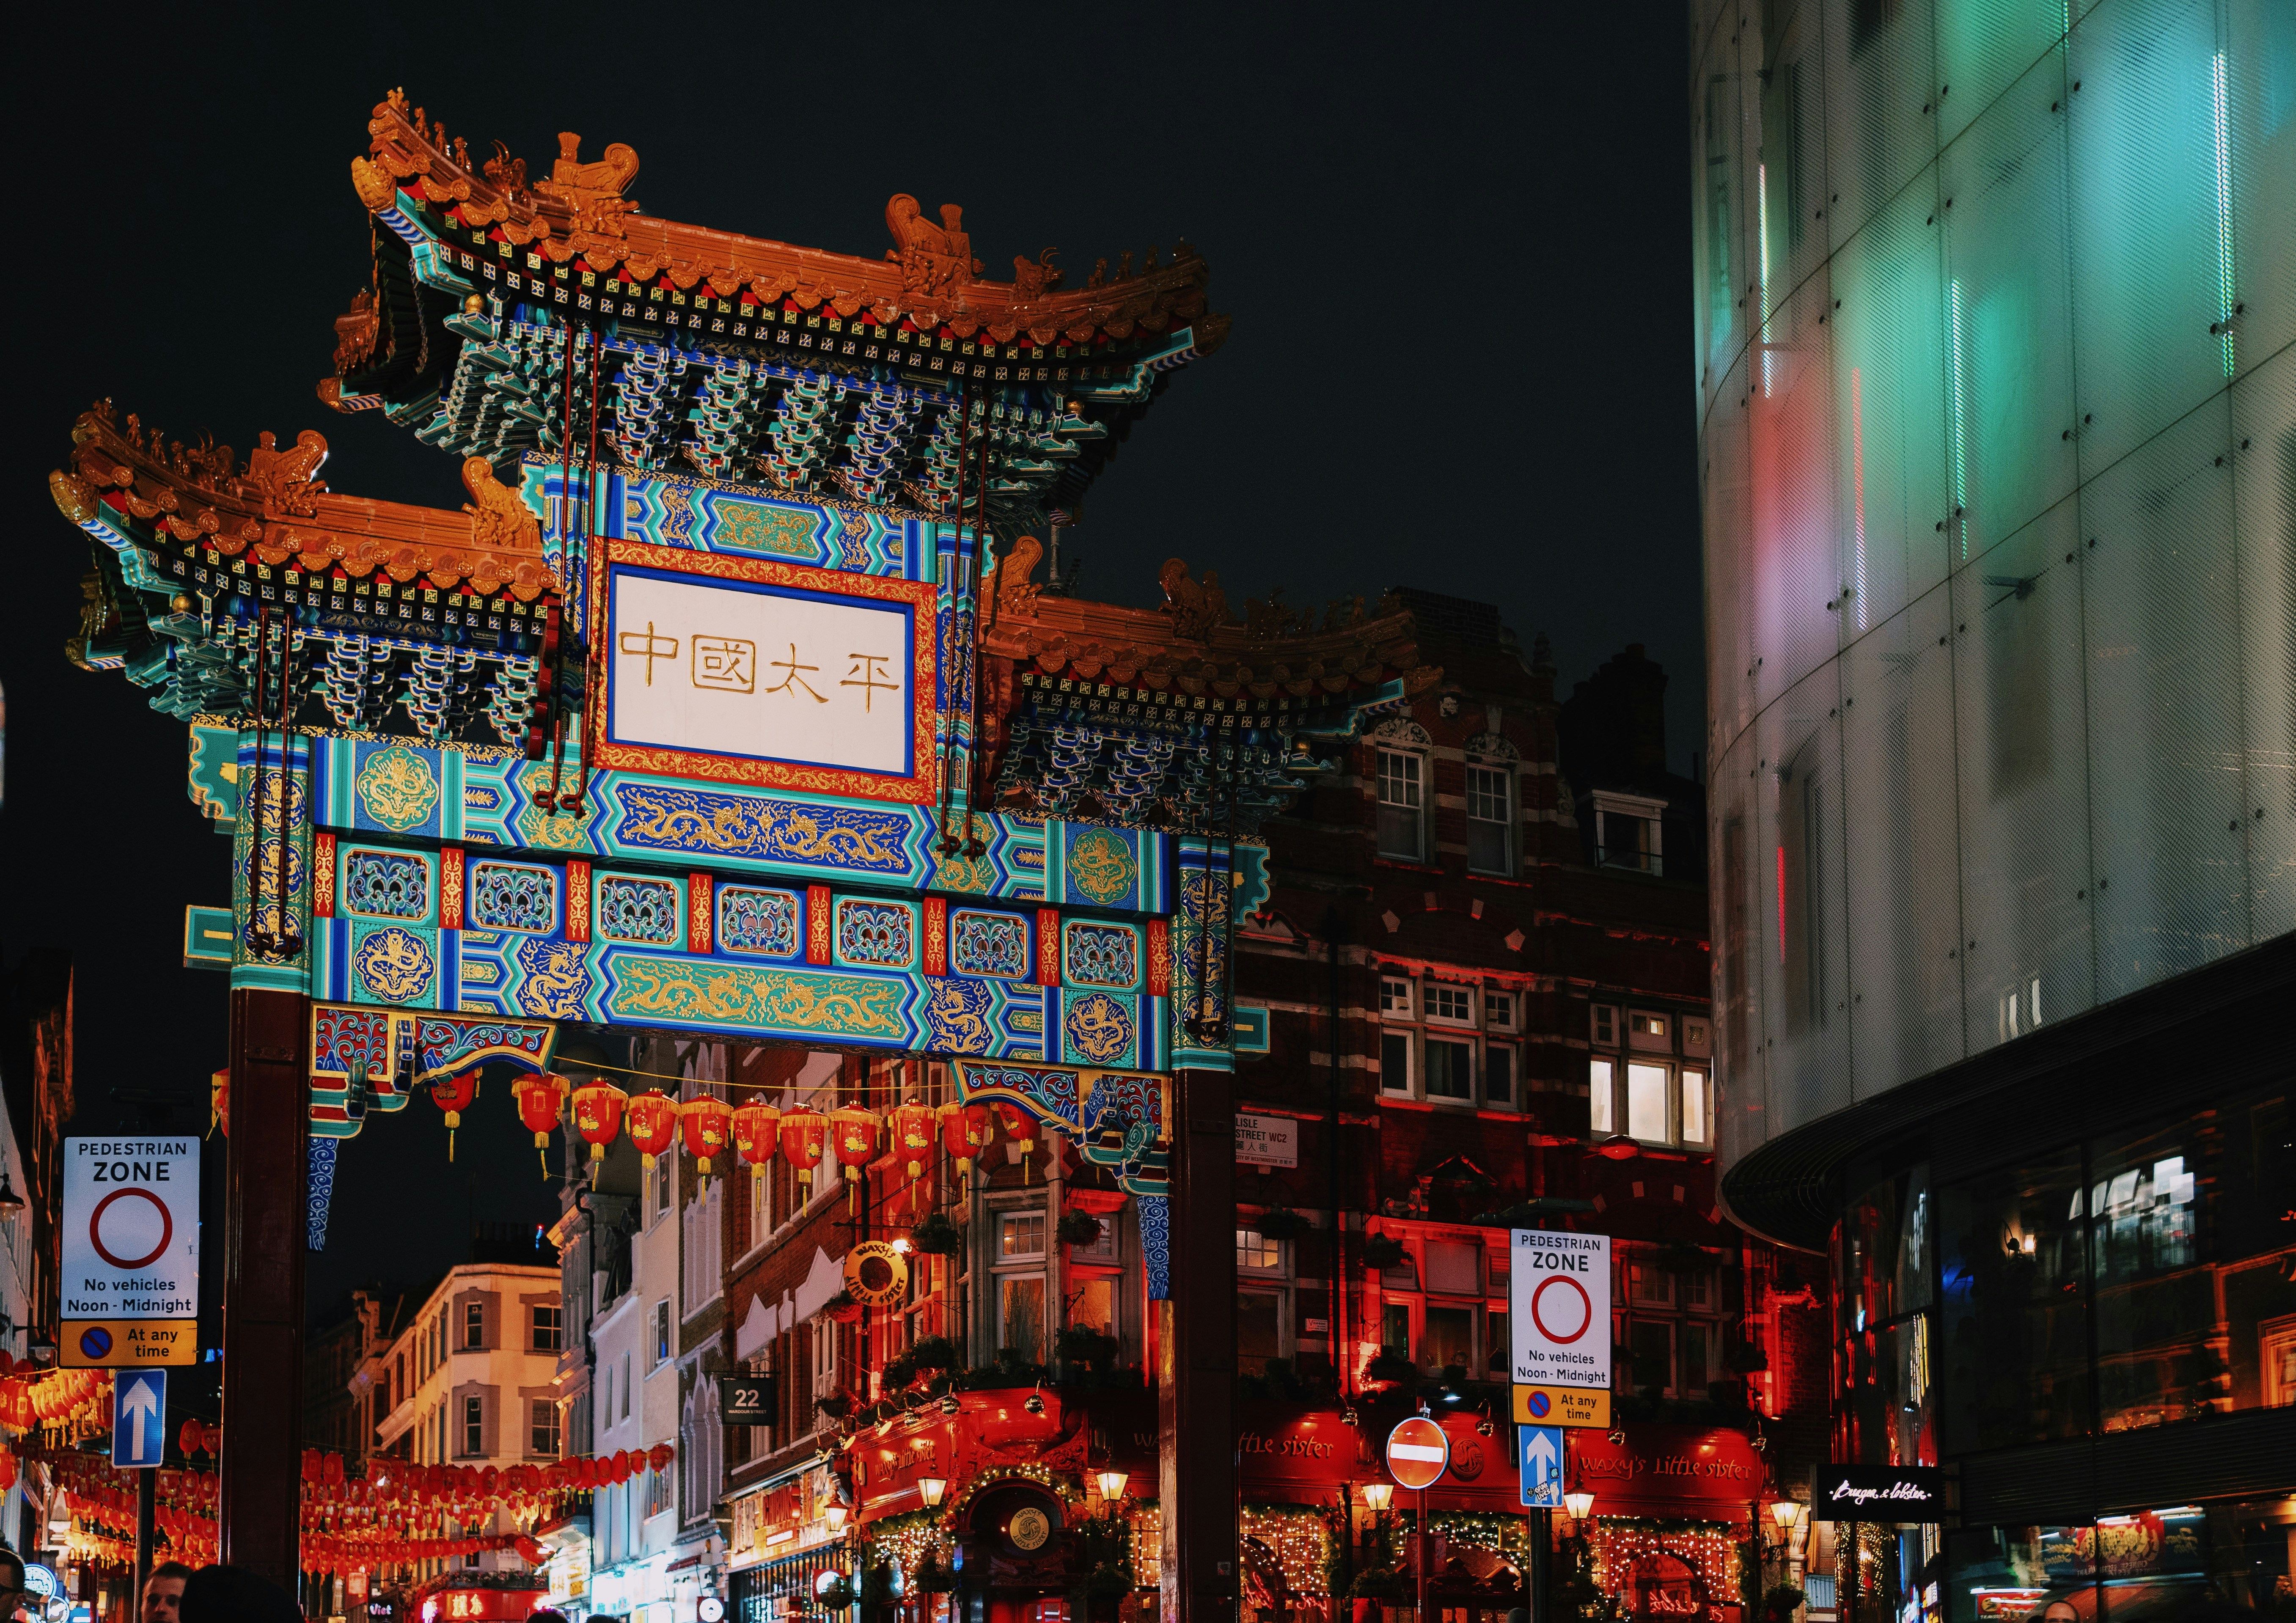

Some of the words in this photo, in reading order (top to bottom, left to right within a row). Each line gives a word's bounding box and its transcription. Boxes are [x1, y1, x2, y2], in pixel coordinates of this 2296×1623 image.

[1236, 1117, 1258, 1128] LISLE
[1236, 1129, 1266, 1140] STREET
[1269, 1132, 1287, 1143] WC2
[79, 1143, 187, 1155] PEDESTRIAN
[93, 1162, 170, 1181] ZONE
[1522, 1235, 1600, 1251] PEDESTRIAN
[1533, 1252, 1589, 1272] ZONE
[85, 1279, 106, 1291] No
[113, 1278, 176, 1290] vehicles
[68, 1299, 108, 1312] Noon
[123, 1298, 191, 1313] Midnight
[127, 1329, 145, 1340] At
[151, 1331, 178, 1343] any
[135, 1345, 169, 1357] time
[1529, 1350, 1545, 1361] No
[1549, 1352, 1594, 1364] vehicles
[1518, 1366, 1547, 1378] Noon
[1557, 1369, 1606, 1383] Midnight
[735, 1389, 759, 1407] 22
[1561, 1394, 1573, 1405] At
[1578, 1397, 1597, 1408] any
[1567, 1408, 1591, 1419] time
[1280, 1435, 1334, 1458] sister
[1705, 1459, 1752, 1480] sister
[1879, 1489, 1889, 1498] &
[369, 1603, 392, 1615] Viet
